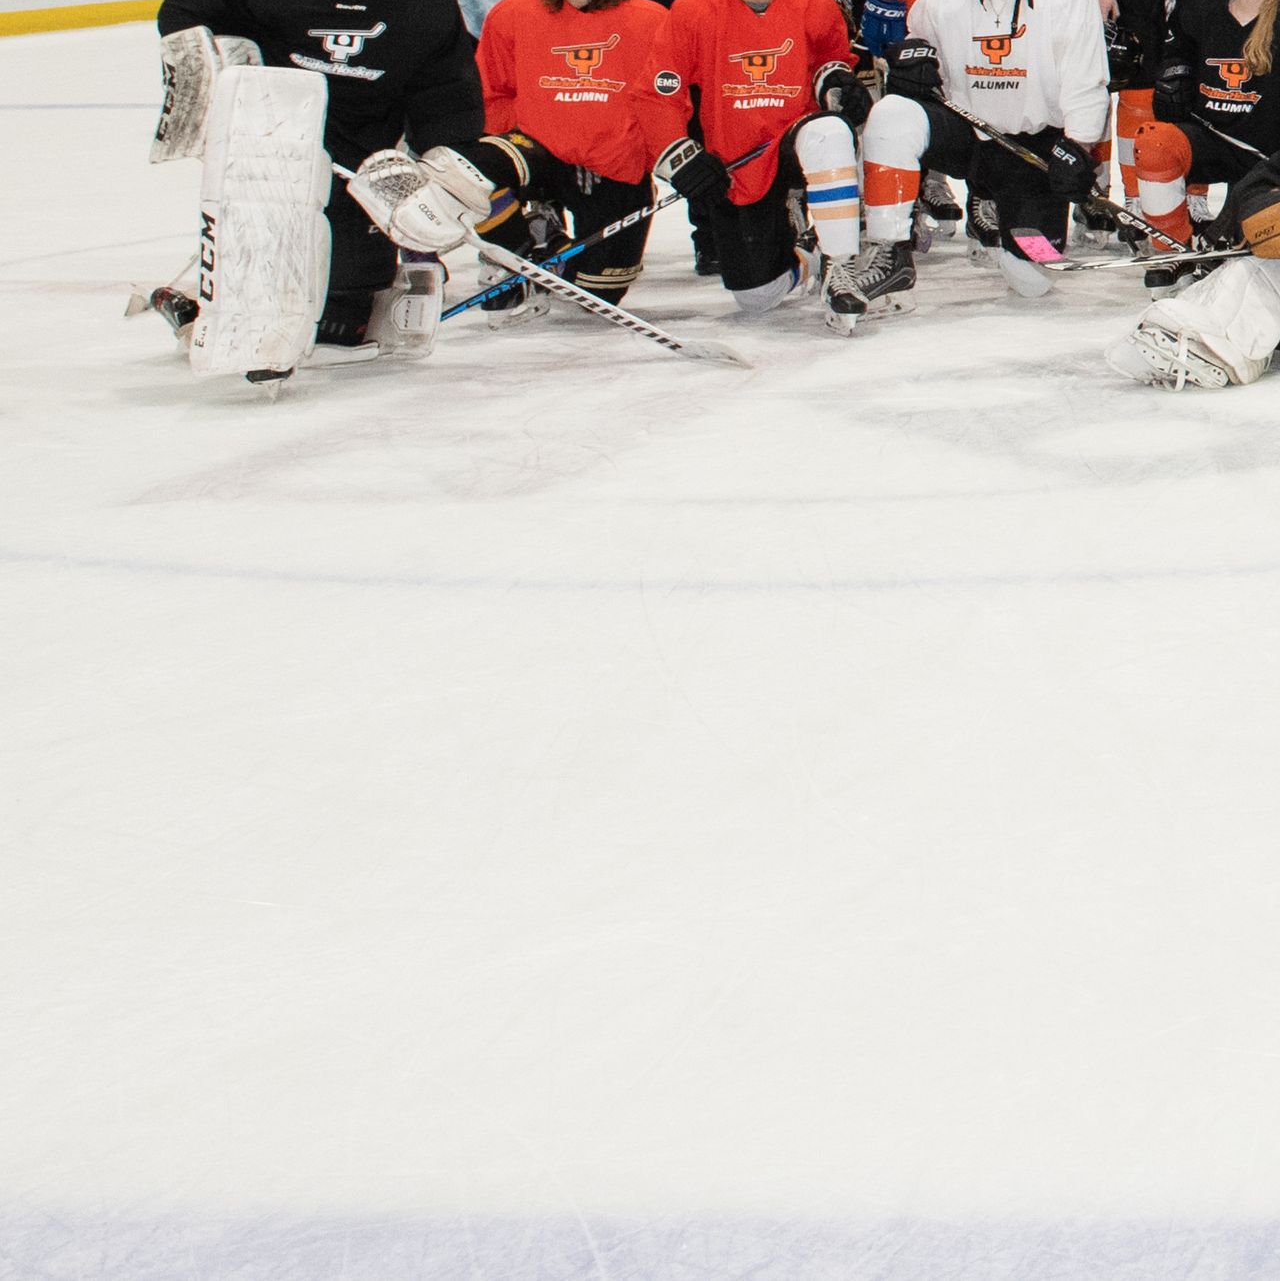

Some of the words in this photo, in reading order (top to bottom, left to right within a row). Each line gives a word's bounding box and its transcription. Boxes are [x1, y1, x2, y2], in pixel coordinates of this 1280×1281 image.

[656, 78, 679, 87] EMS
[971, 80, 1020, 91] ALUMNI
[554, 92, 609, 102] ALUMNI
[733, 98, 785, 109] ALUMNI
[1117, 211, 1186, 253] BAUER
[201, 211, 215, 302] CCM
[519, 265, 682, 350] WARRIOR
